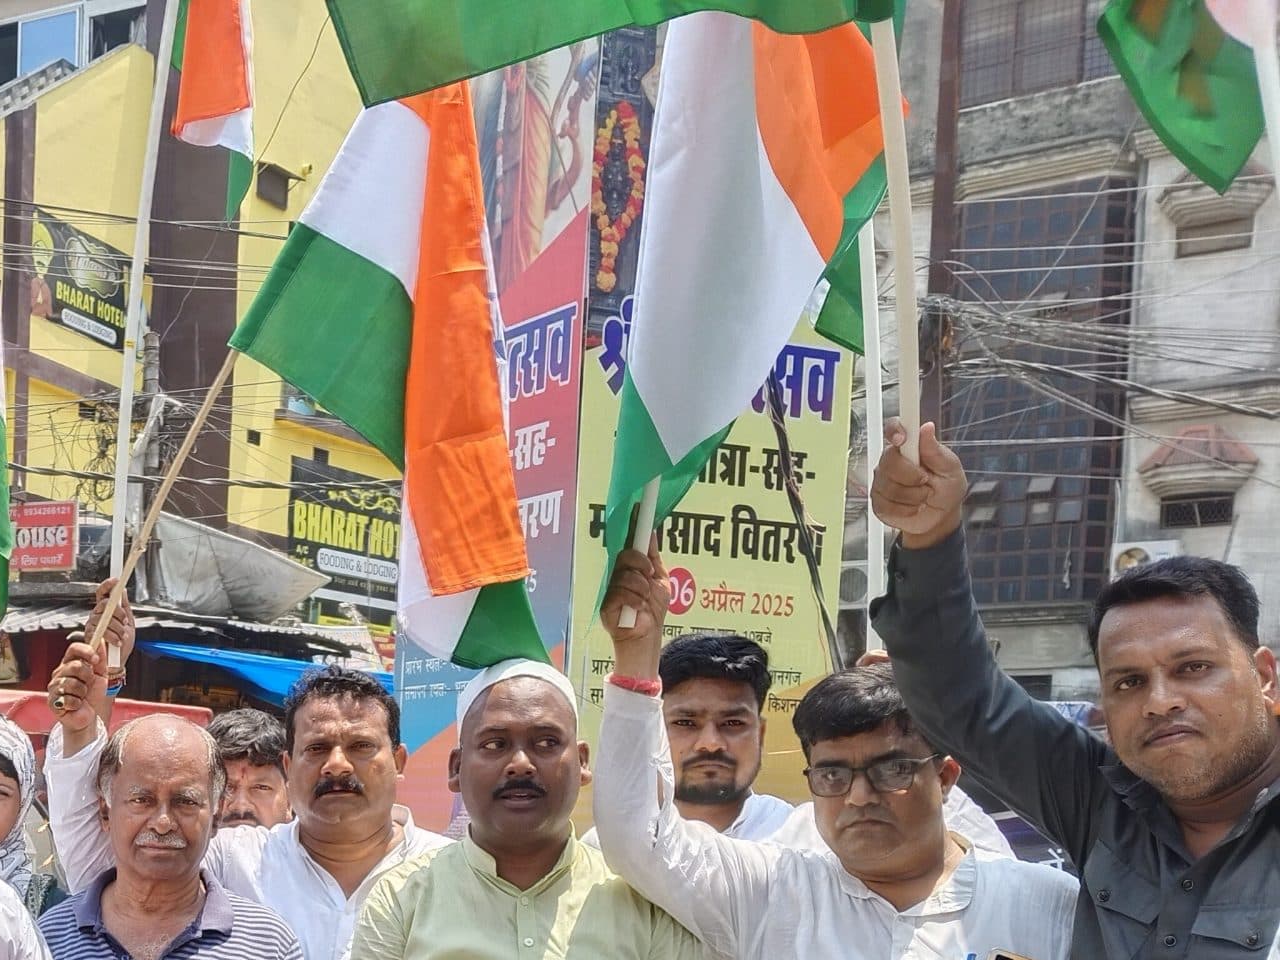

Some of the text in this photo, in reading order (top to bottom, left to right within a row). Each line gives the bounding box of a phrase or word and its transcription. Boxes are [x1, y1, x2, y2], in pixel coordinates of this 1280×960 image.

[55, 280, 126, 328] BHARAT HOTEL
[16, 525, 69, 549] ouse
[293, 499, 369, 552] BHARAT
[320, 552, 355, 573] FOODING
[356, 561, 363, 573] &
[364, 562, 397, 581] LODGING
[699, 579, 746, 614] अप्रैल
[750, 592, 795, 618] 2025
